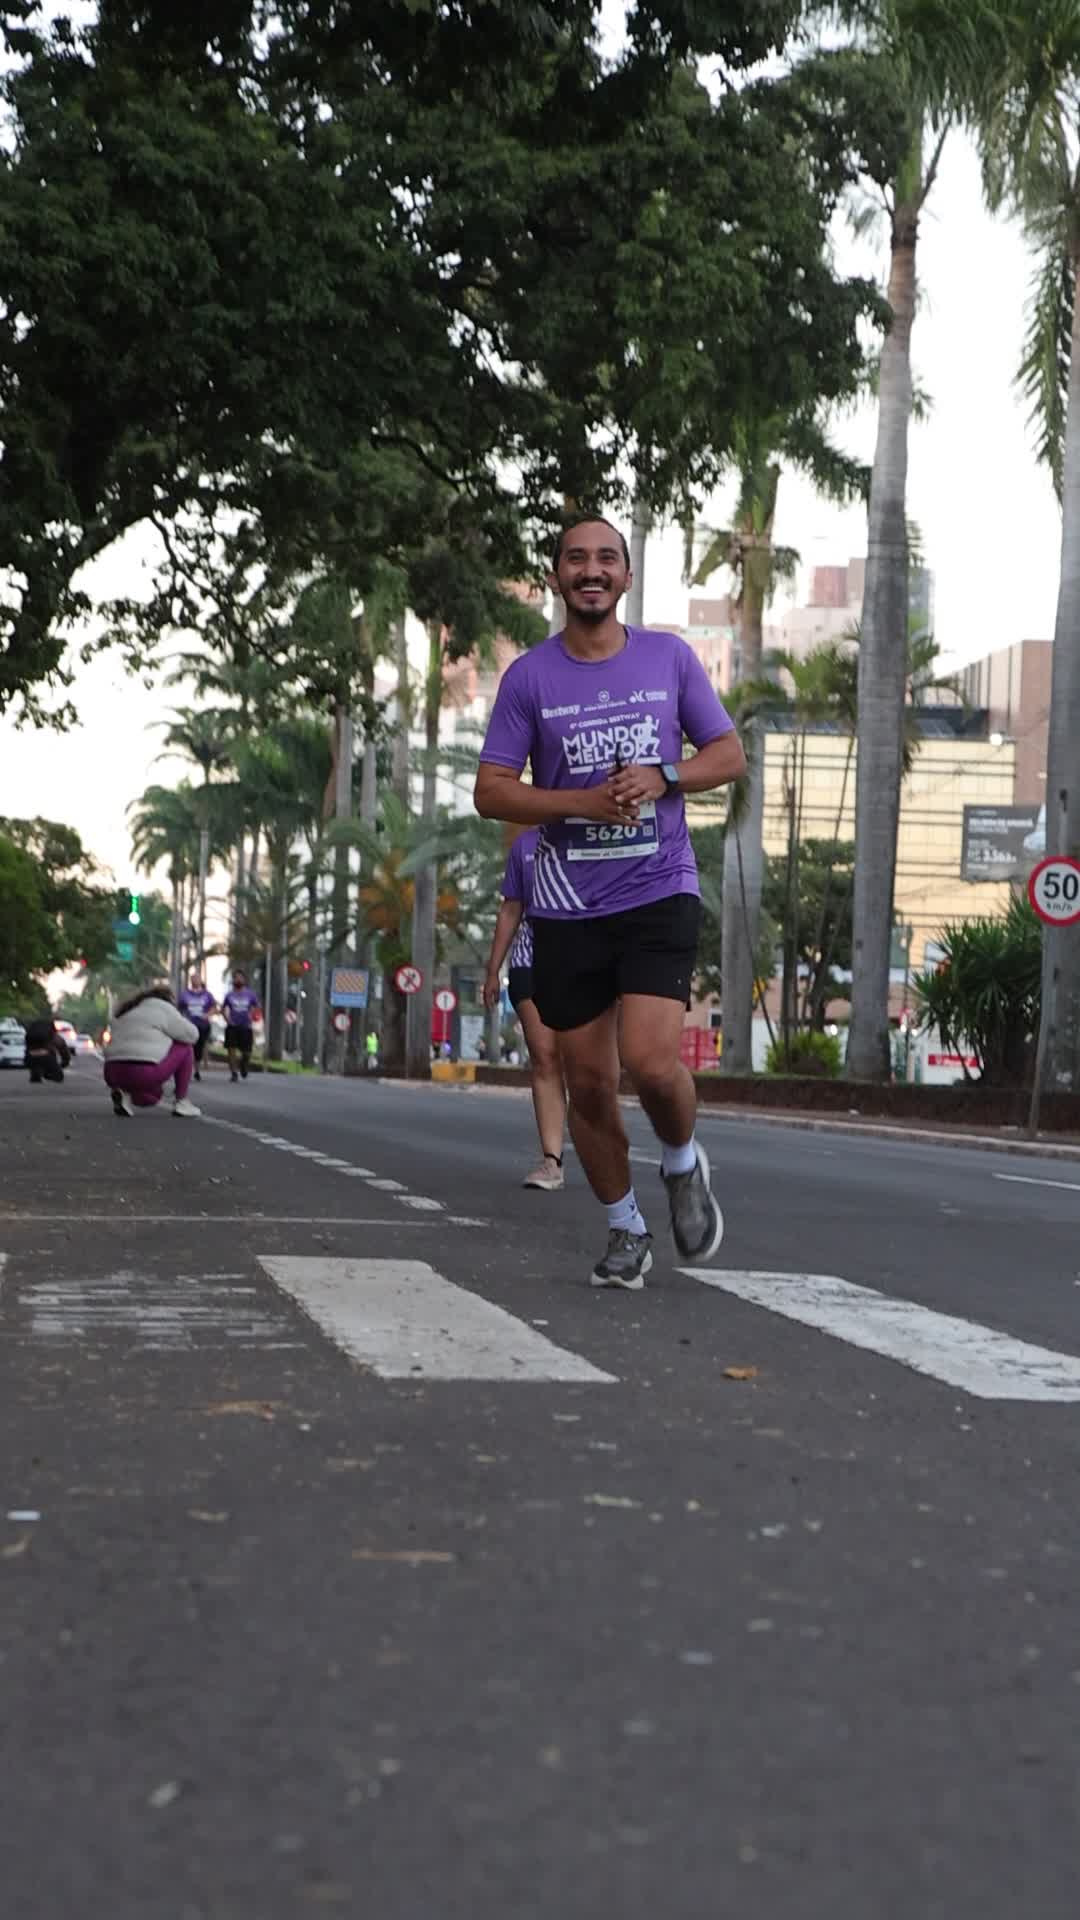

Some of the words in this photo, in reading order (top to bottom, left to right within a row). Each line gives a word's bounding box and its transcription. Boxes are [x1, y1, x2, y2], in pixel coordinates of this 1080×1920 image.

[608, 712, 641, 723] BESTWAY
[562, 723, 648, 751] MUNDO
[585, 825, 637, 841] 5620
[1044, 872, 1079, 901] 50
[1046, 902, 1073, 912] km/h
